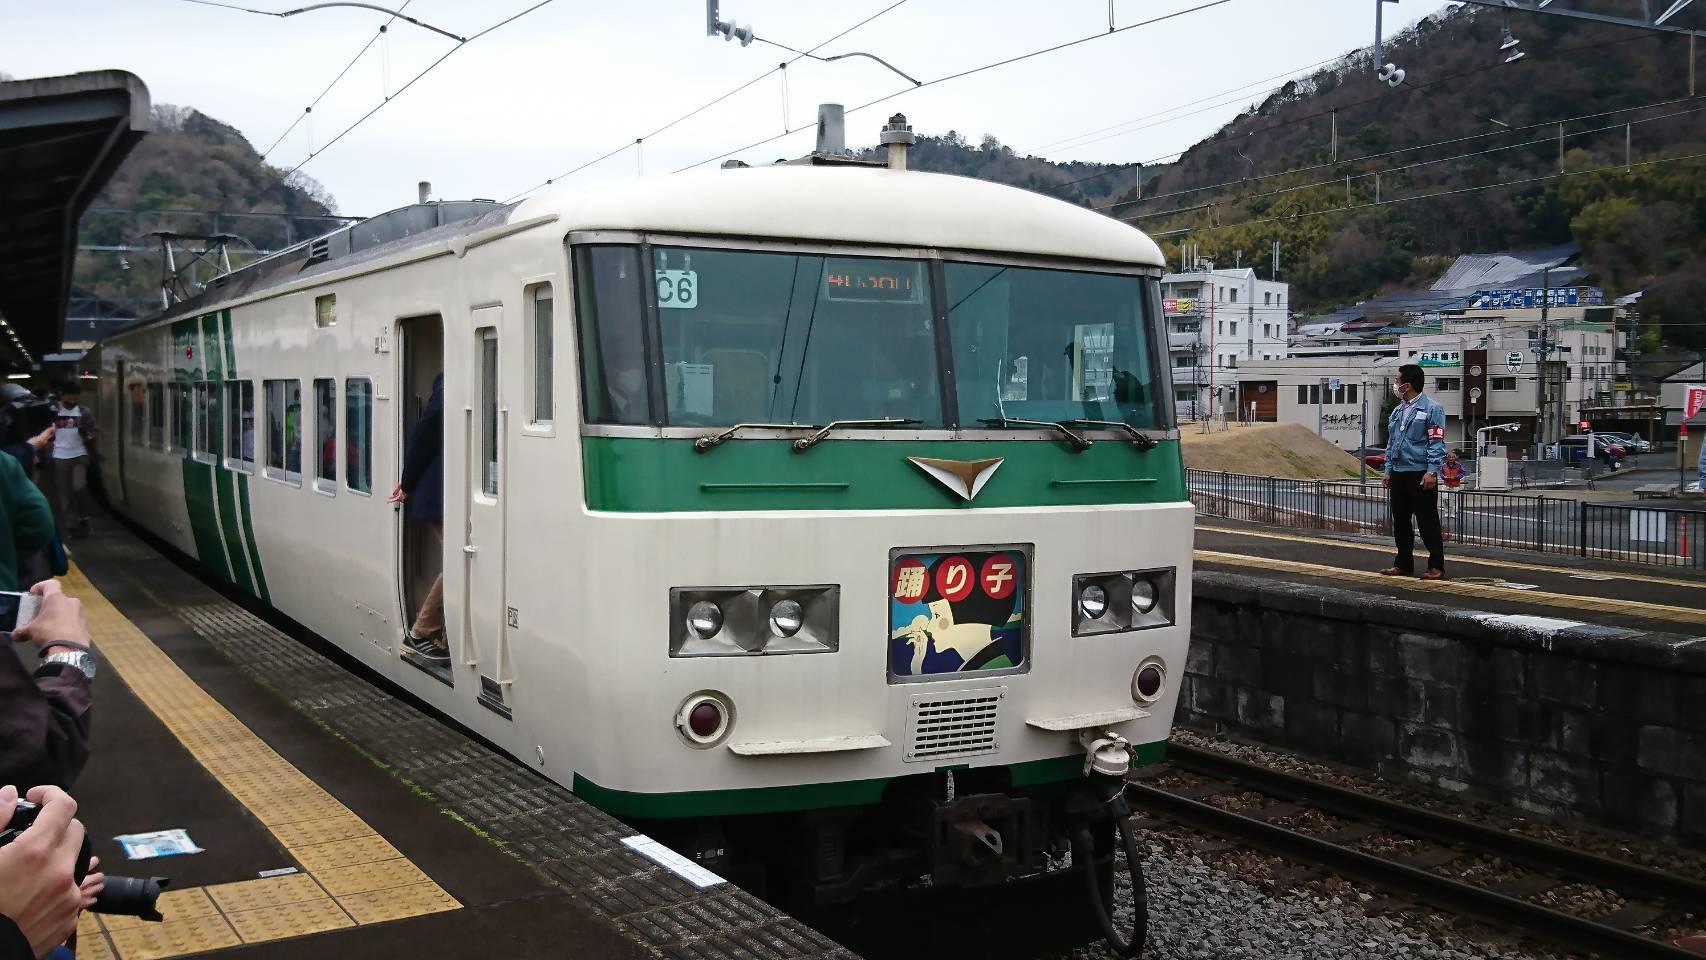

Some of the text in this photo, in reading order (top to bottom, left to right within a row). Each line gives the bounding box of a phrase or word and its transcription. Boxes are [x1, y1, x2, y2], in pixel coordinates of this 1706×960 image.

[657, 277, 692, 303] C6
[1421, 352, 1460, 361] 石井歯科
[895, 564, 1013, 598] 踊り子
